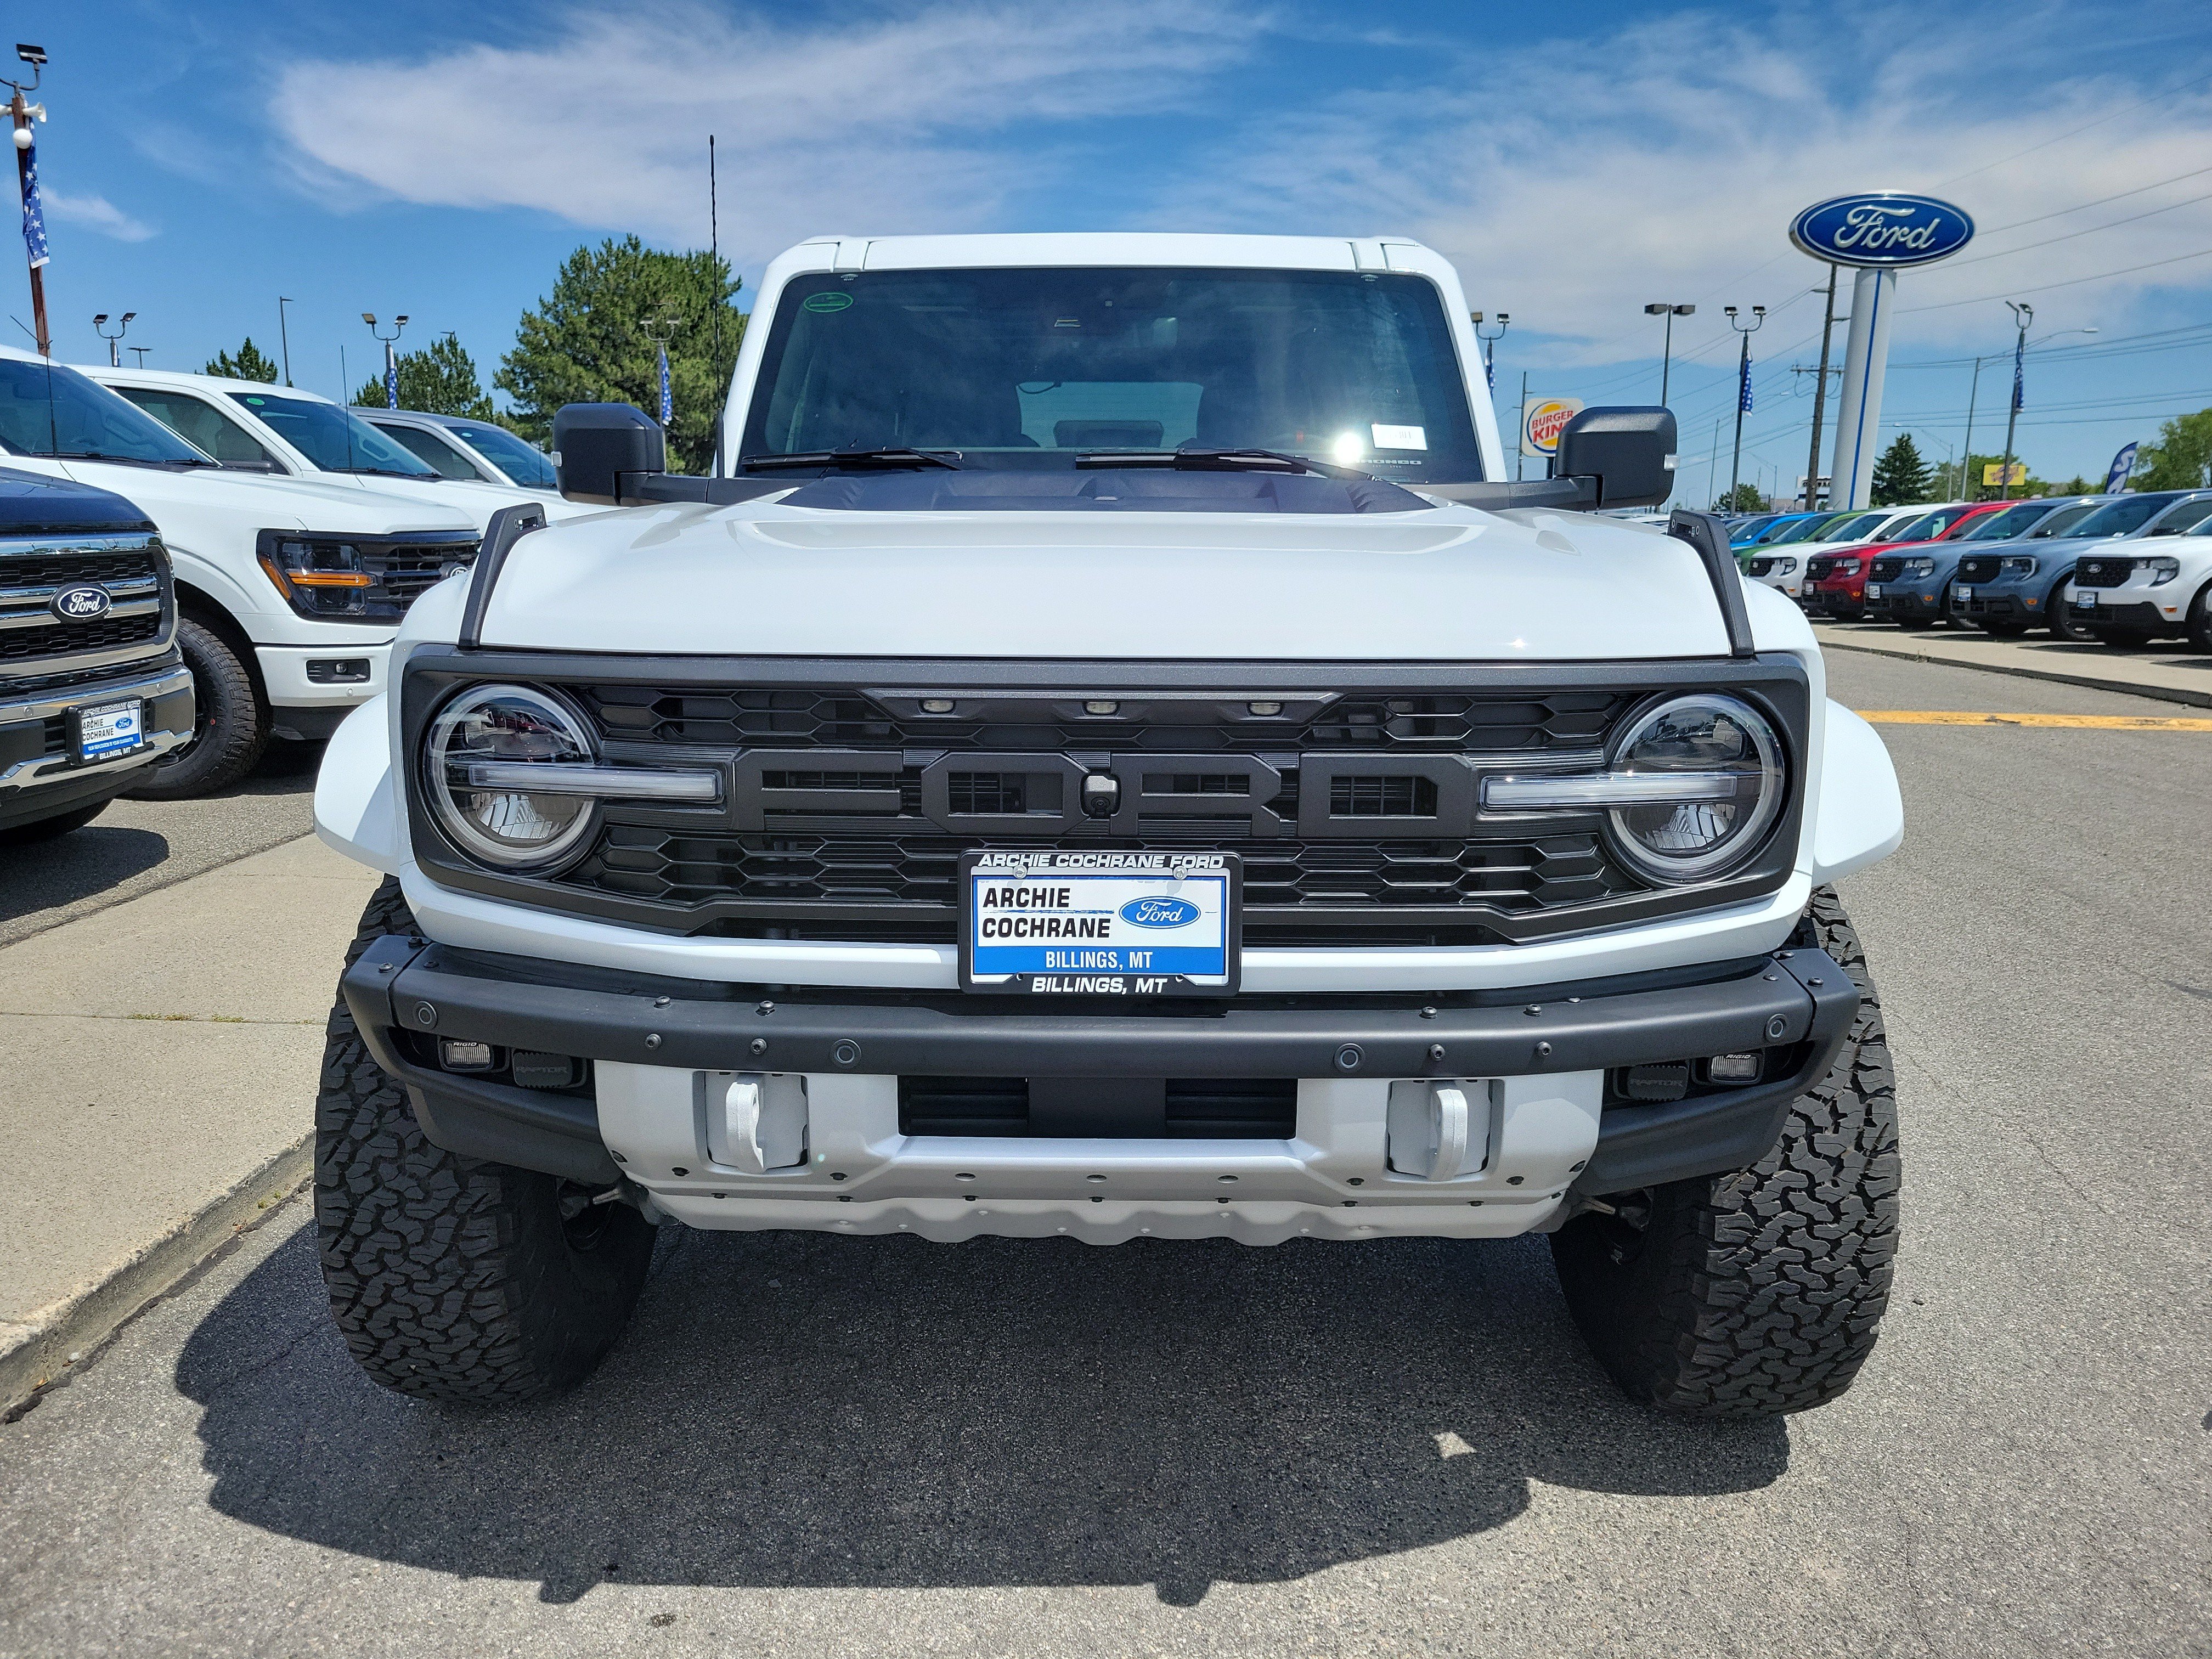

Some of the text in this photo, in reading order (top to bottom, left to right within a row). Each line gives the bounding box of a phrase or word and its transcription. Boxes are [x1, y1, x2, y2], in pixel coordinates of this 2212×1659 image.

[1834, 205, 1941, 249] Ford
[1532, 410, 1574, 430] BURGER
[1532, 422, 1566, 443] KIN
[69, 592, 100, 613] Ford
[84, 707, 100, 715] ARCHIE
[101, 702, 127, 712] COCHRANE
[82, 727, 114, 742] COCHRANE
[83, 719, 130, 730] ARCHIE Ford
[99, 747, 131, 760] BILLINGS, MT
[733, 749, 1472, 838] FORD
[978, 854, 1224, 869] ARCHIE COCHRANE FORD
[982, 887, 1183, 923] ARCHIE Ford
[982, 917, 1111, 939] COCHRANE
[1046, 951, 1153, 971] BILLINGS, MT
[1031, 977, 1168, 995] BILLINGS, MT
